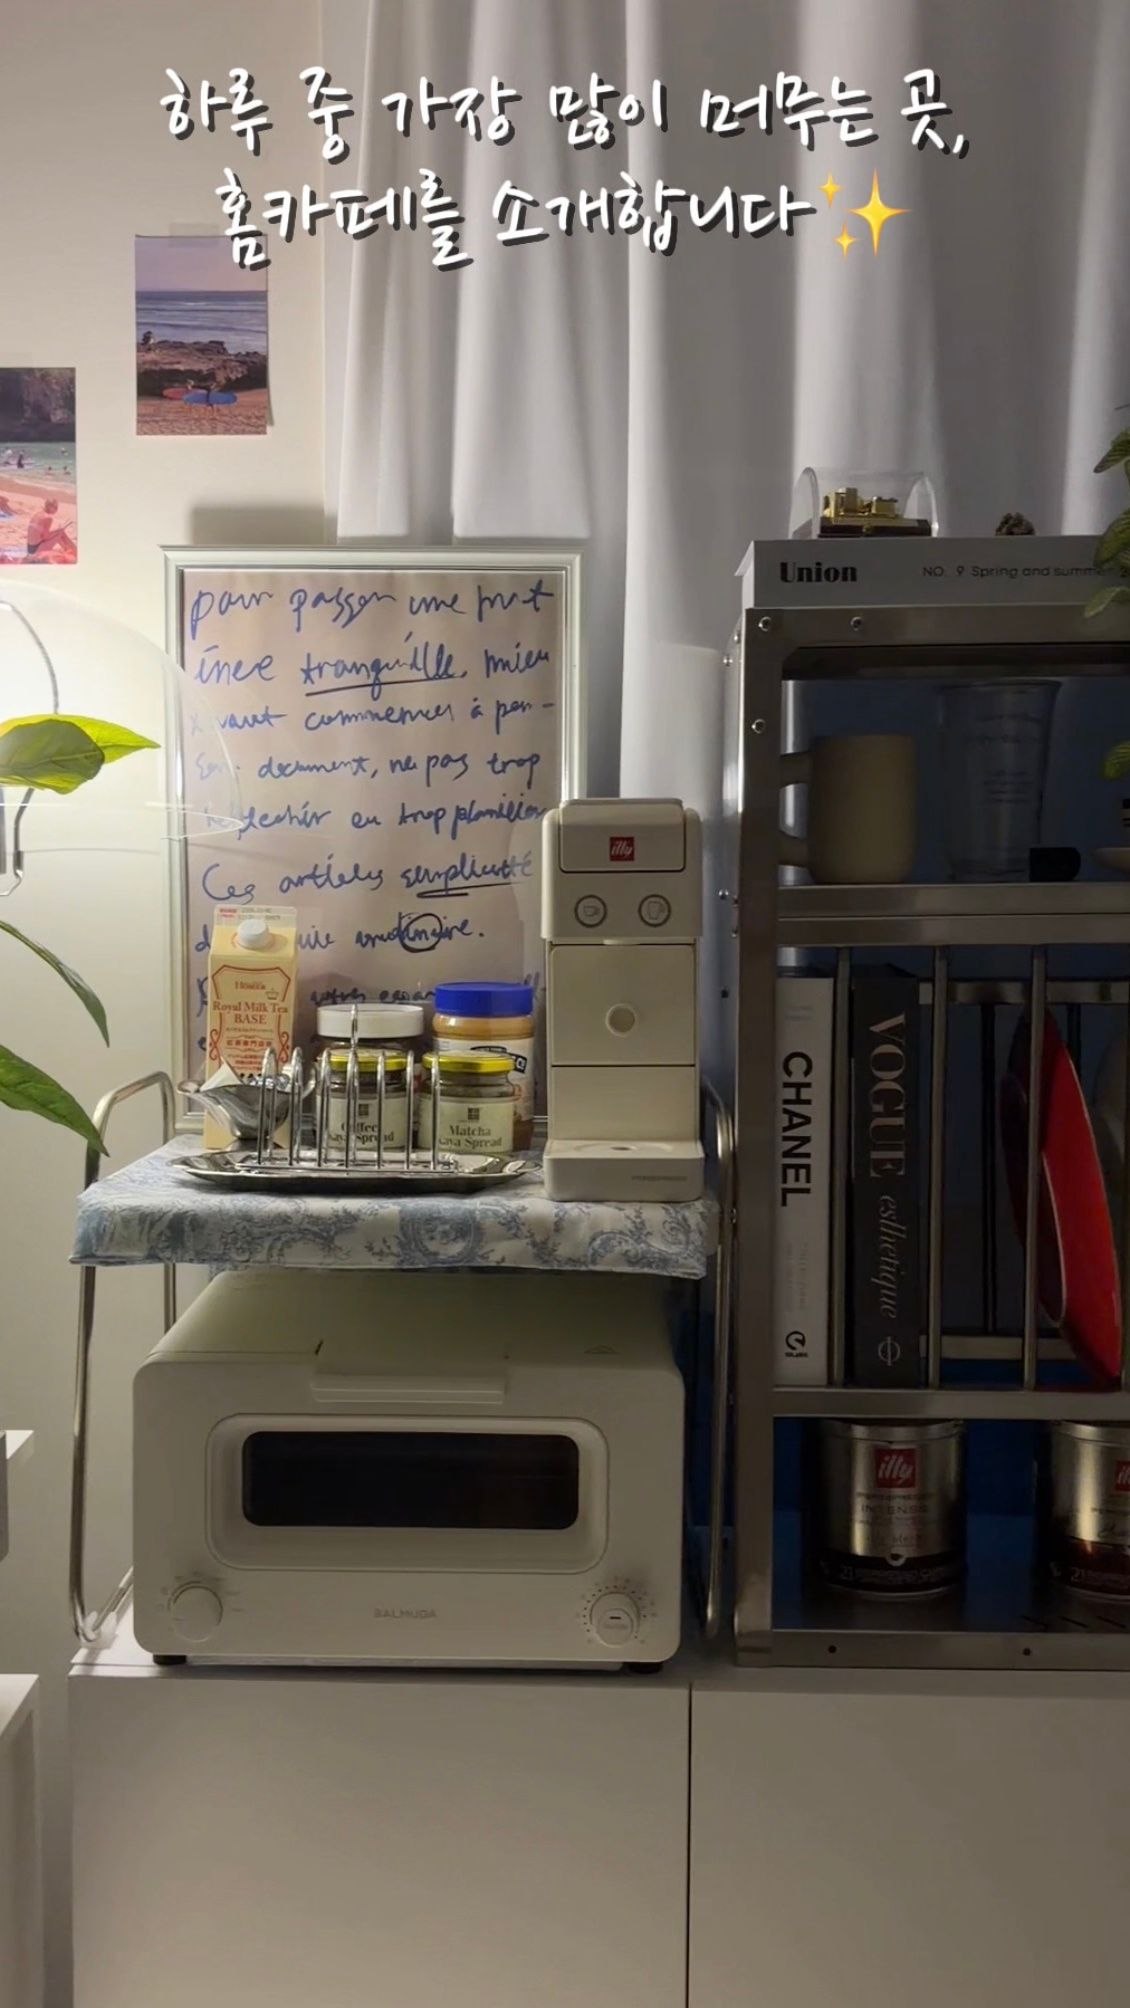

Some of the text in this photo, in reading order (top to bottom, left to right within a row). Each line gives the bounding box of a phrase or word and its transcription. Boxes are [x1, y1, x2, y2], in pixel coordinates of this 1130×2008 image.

[780, 562, 858, 582] Union
[956, 565, 965, 577] 9
[971, 566, 1018, 579] Spring
[1022, 566, 1050, 577] and
[611, 840, 633, 858] illy
[213, 1001, 288, 1014] Royal Milk Tea
[234, 1014, 267, 1025] BASE
[869, 1013, 905, 1178] VOGUE
[449, 1125, 492, 1137] Matcha
[780, 1051, 813, 1207] CHANEL
[878, 1454, 914, 1486] illy
